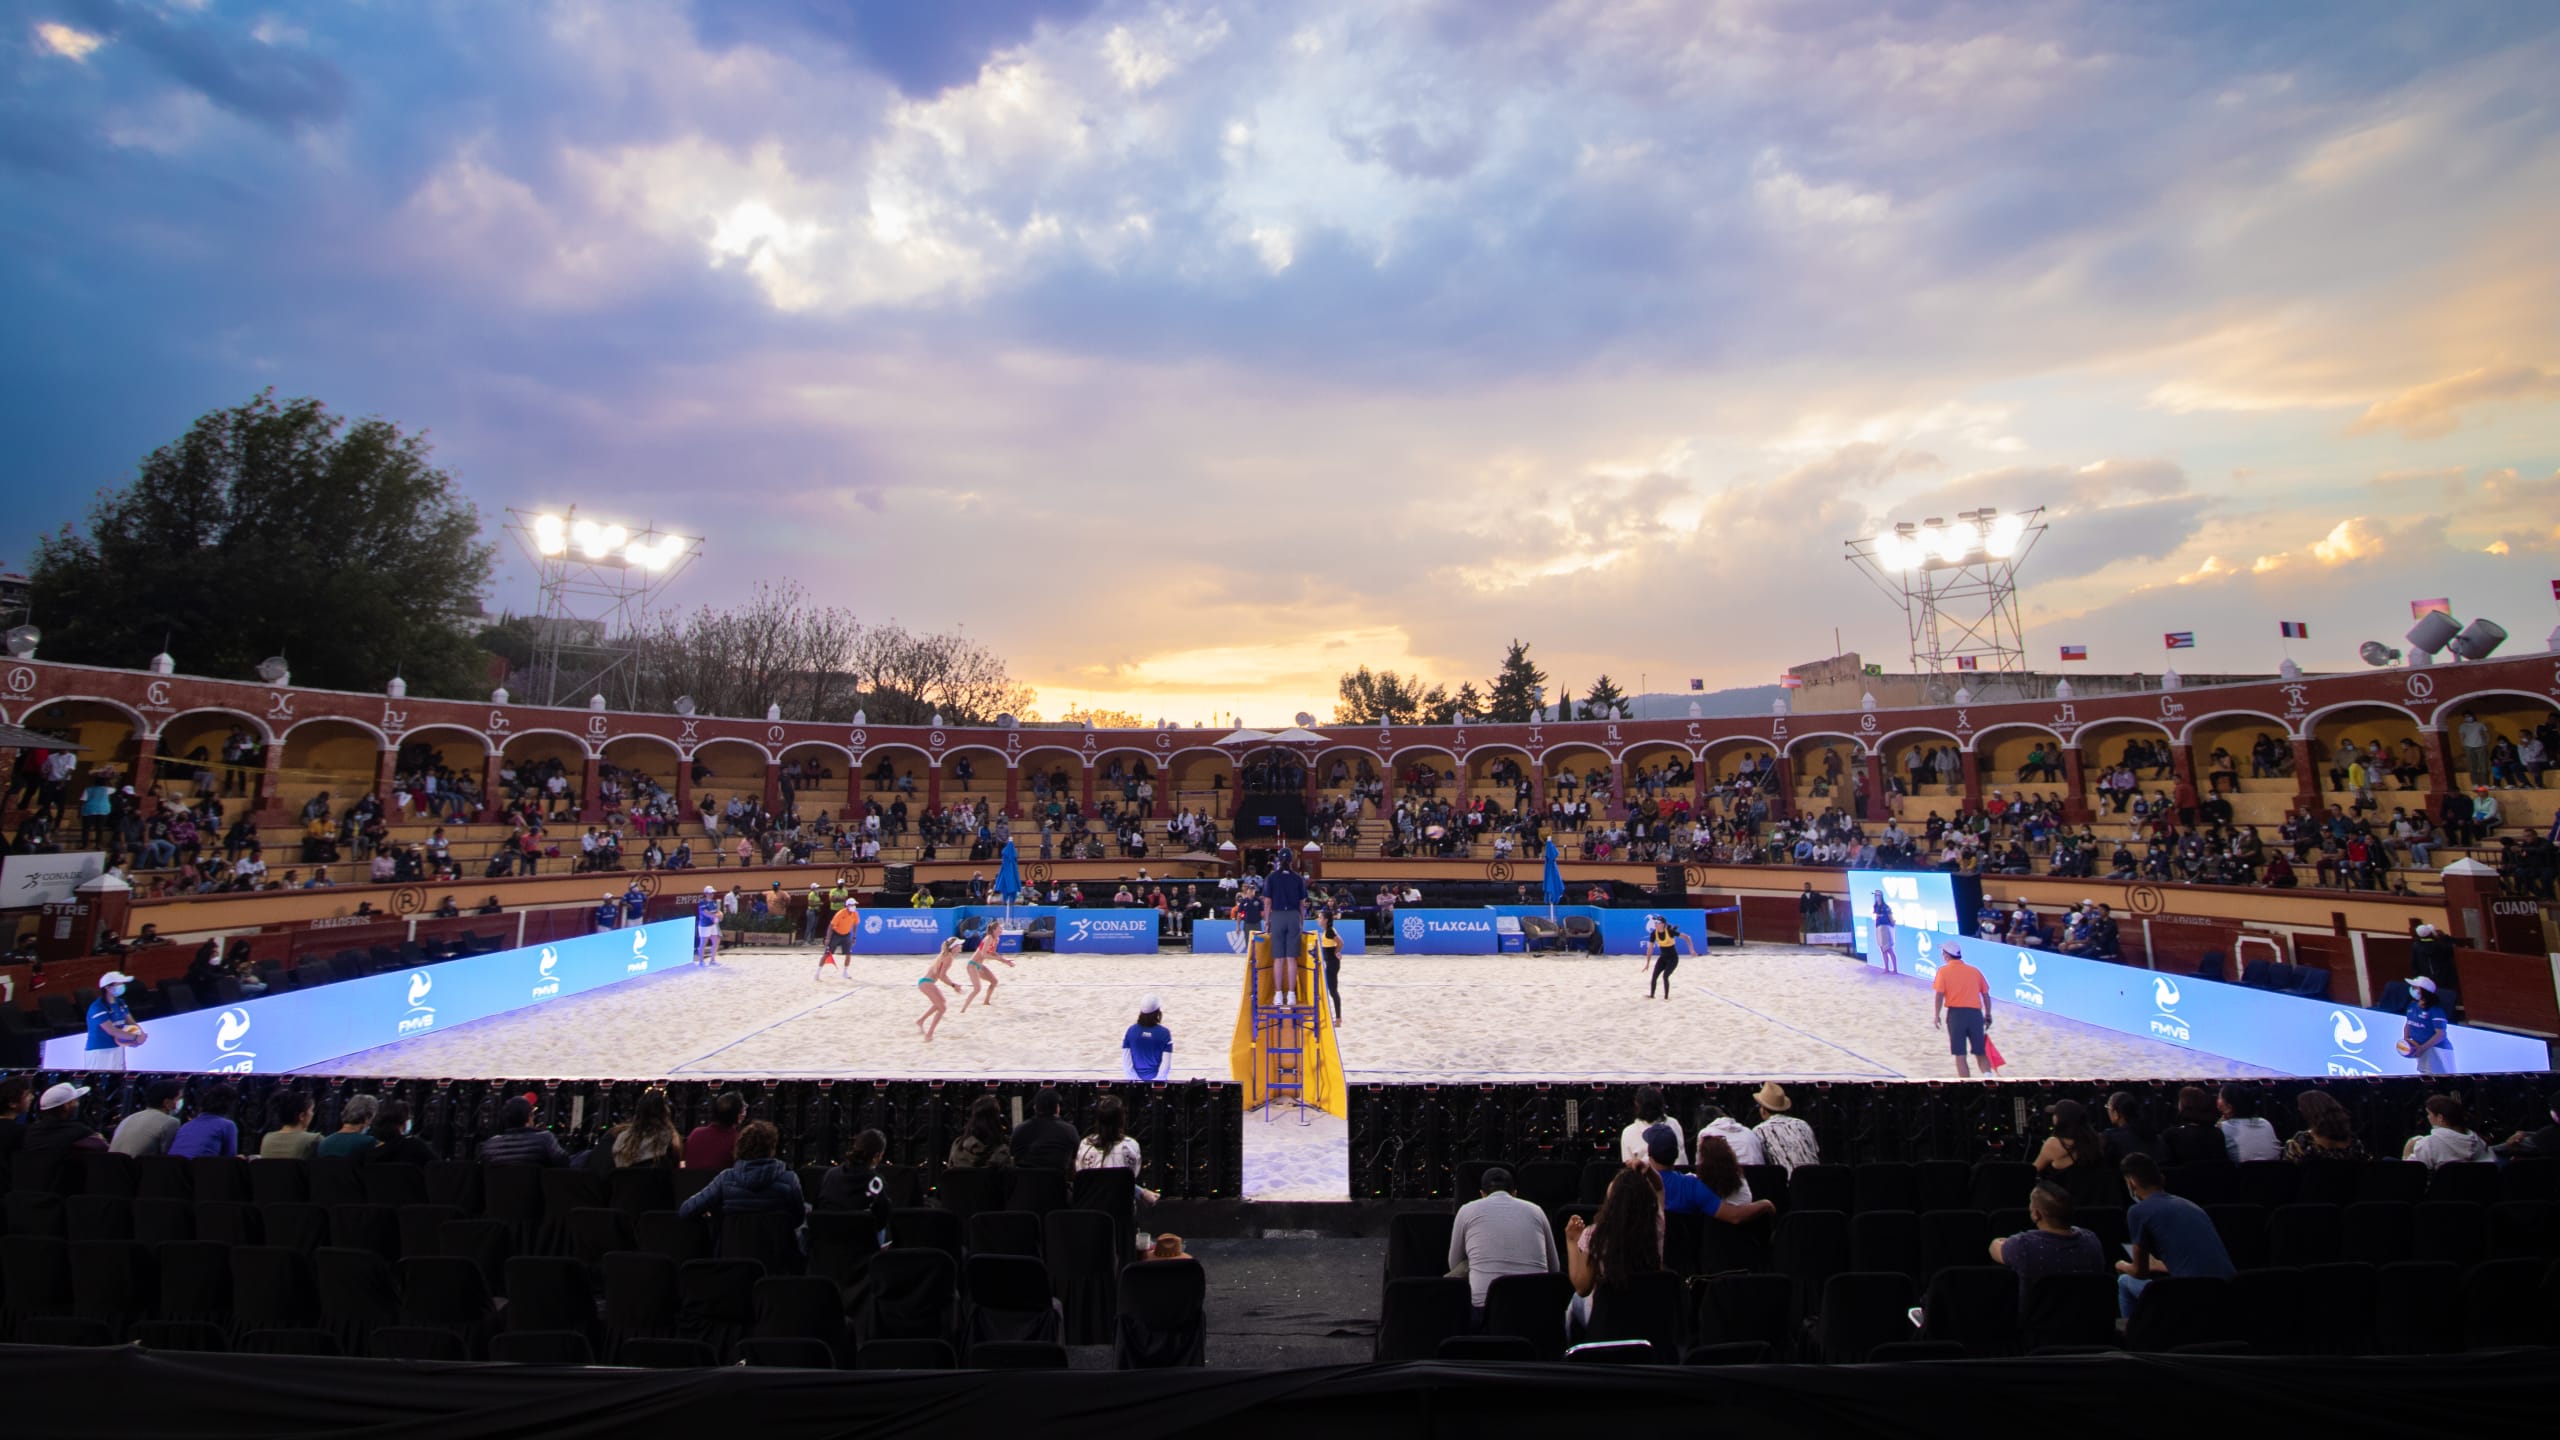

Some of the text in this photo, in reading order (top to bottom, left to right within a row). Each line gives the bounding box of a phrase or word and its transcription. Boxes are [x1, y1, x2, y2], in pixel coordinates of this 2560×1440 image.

[1092, 920, 1147, 931] CONADE
[1428, 921, 1490, 931] TLAXCALA
[398, 1014, 434, 1033] FMVB
[2150, 1021, 2190, 1041] FMVB
